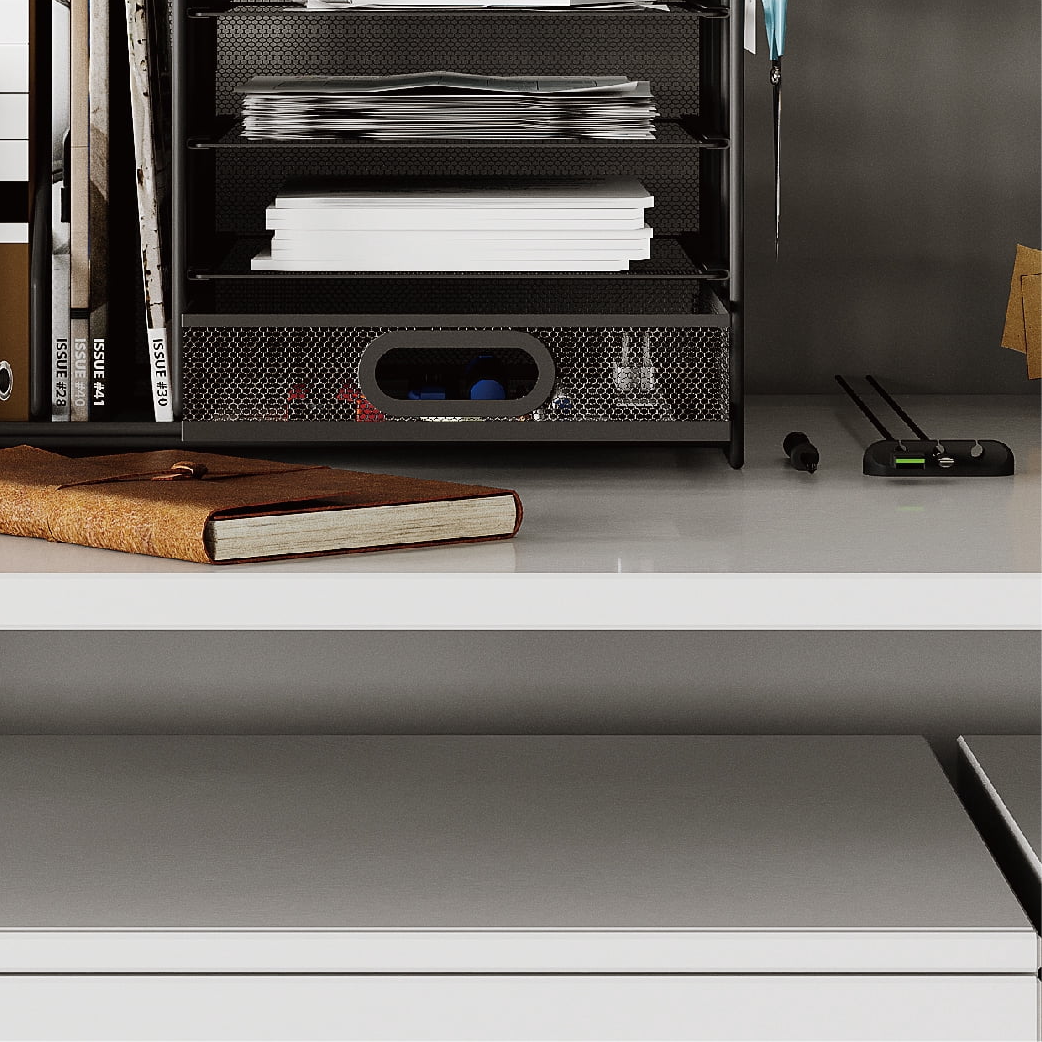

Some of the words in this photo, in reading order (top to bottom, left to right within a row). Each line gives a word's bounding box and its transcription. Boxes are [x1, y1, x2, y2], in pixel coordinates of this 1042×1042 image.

[56, 338, 68, 378] ISSUE
[74, 338, 86, 378] ISSUE
[93, 338, 105, 379] ISSUE
[152, 338, 167, 378] ISSUE
[56, 381, 67, 407] #28
[74, 381, 86, 407] #40
[93, 382, 105, 406] #41
[156, 381, 168, 407] #30
